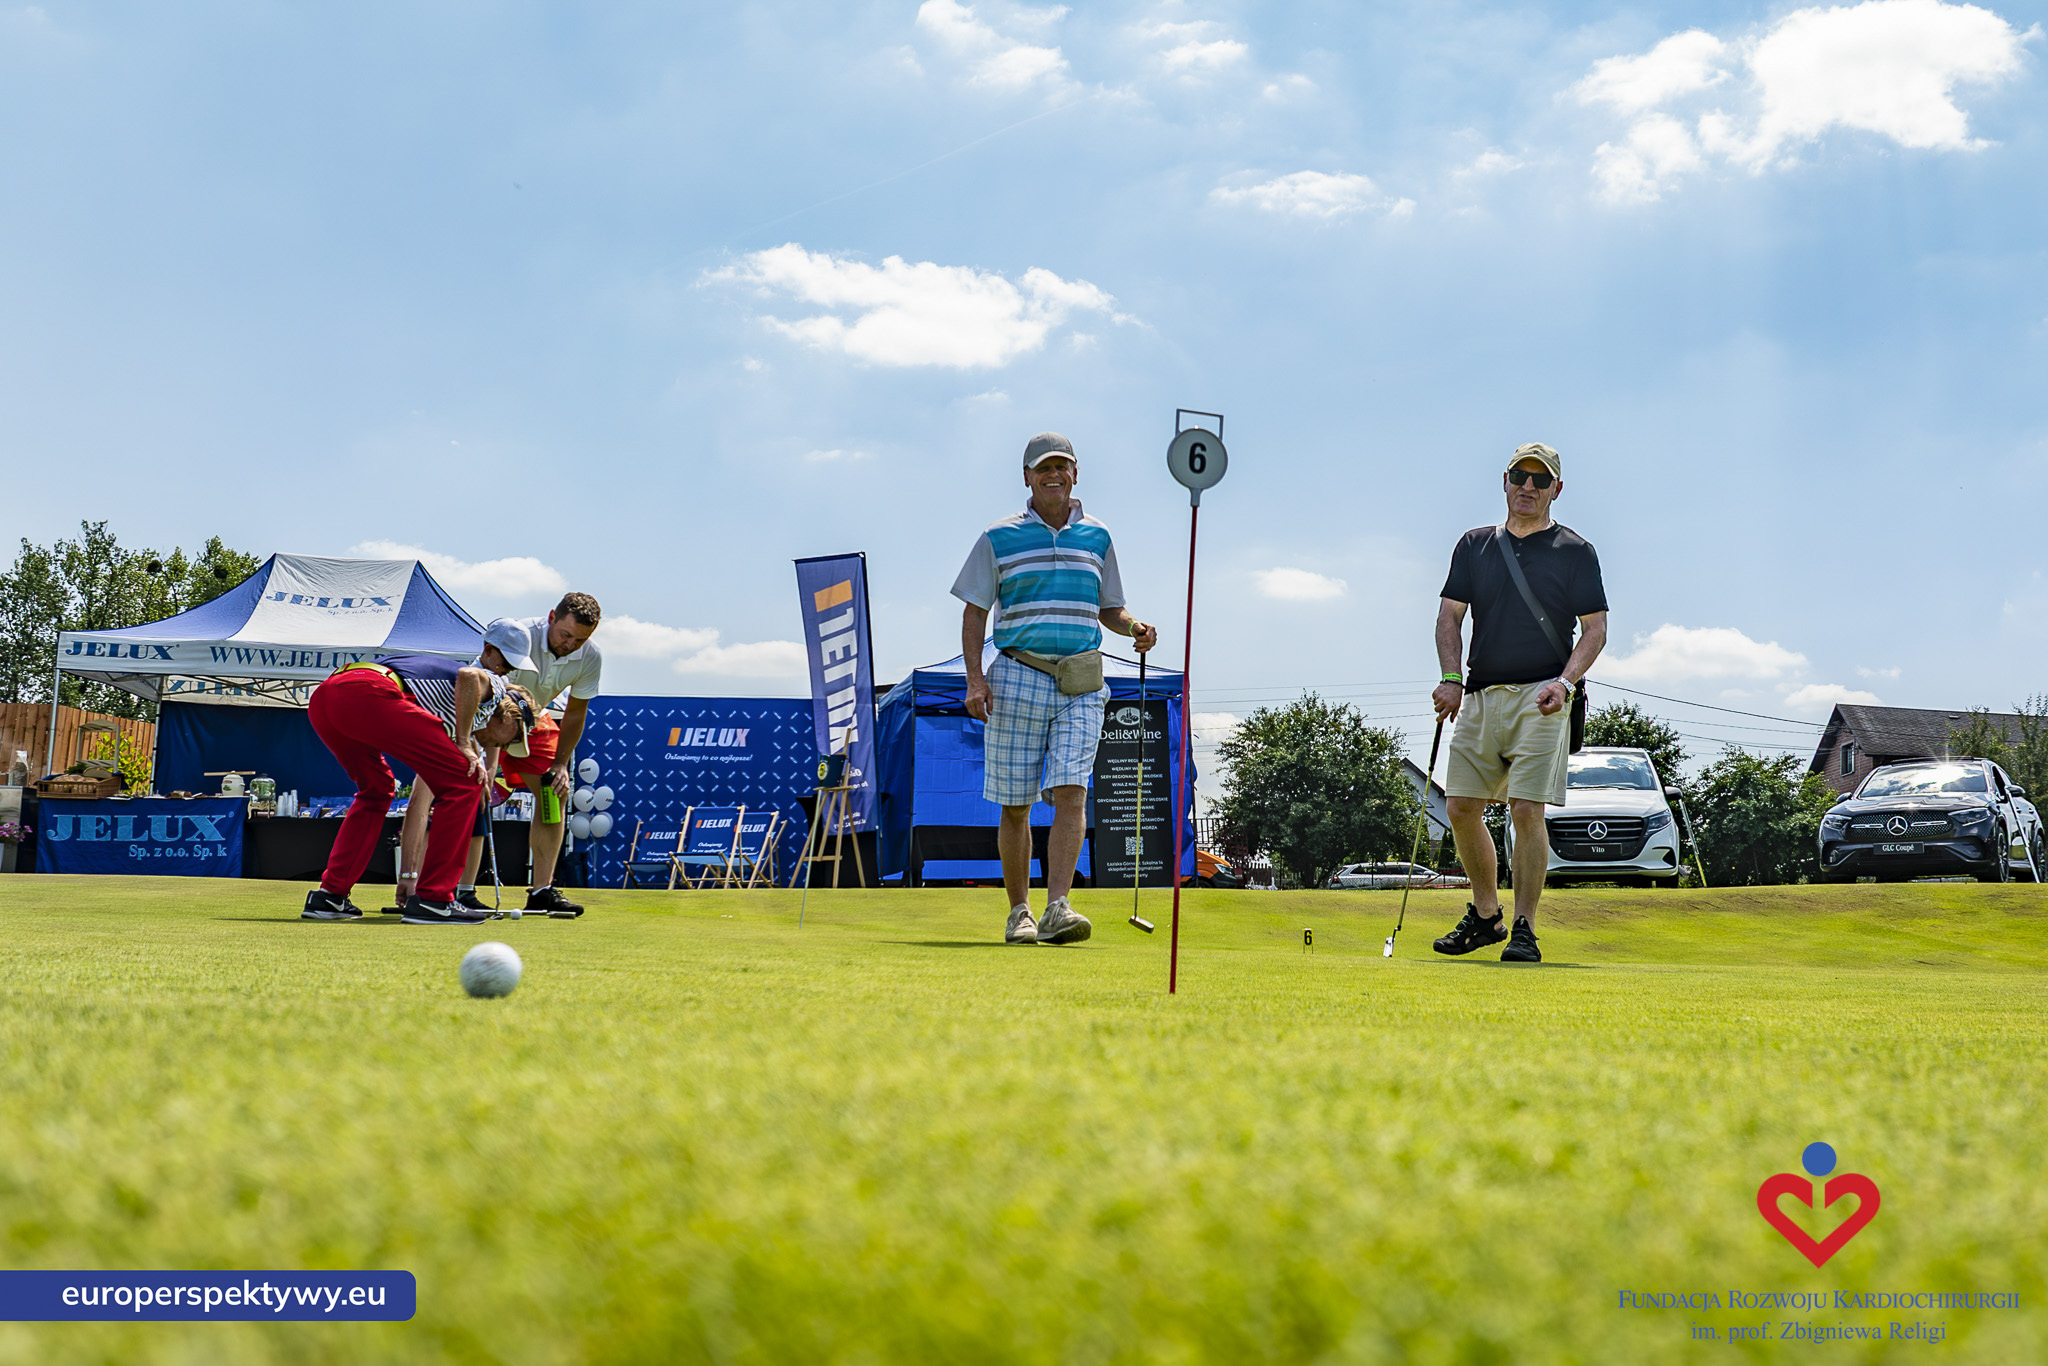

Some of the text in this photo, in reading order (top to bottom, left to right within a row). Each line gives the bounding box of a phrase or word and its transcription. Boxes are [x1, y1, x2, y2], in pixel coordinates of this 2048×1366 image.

[1189, 442, 1207, 475] 6
[266, 591, 394, 608] JELUX
[65, 641, 174, 660] JELUX
[680, 727, 750, 747] JELUX
[46, 814, 226, 842] JELUX
[701, 819, 732, 829] JELUX
[649, 831, 677, 840] JELUX
[129, 844, 227, 861] Sp. z o.o. Sp. k
[1882, 843, 1915, 853] GLC Coupé
[1304, 930, 1312, 946] 6
